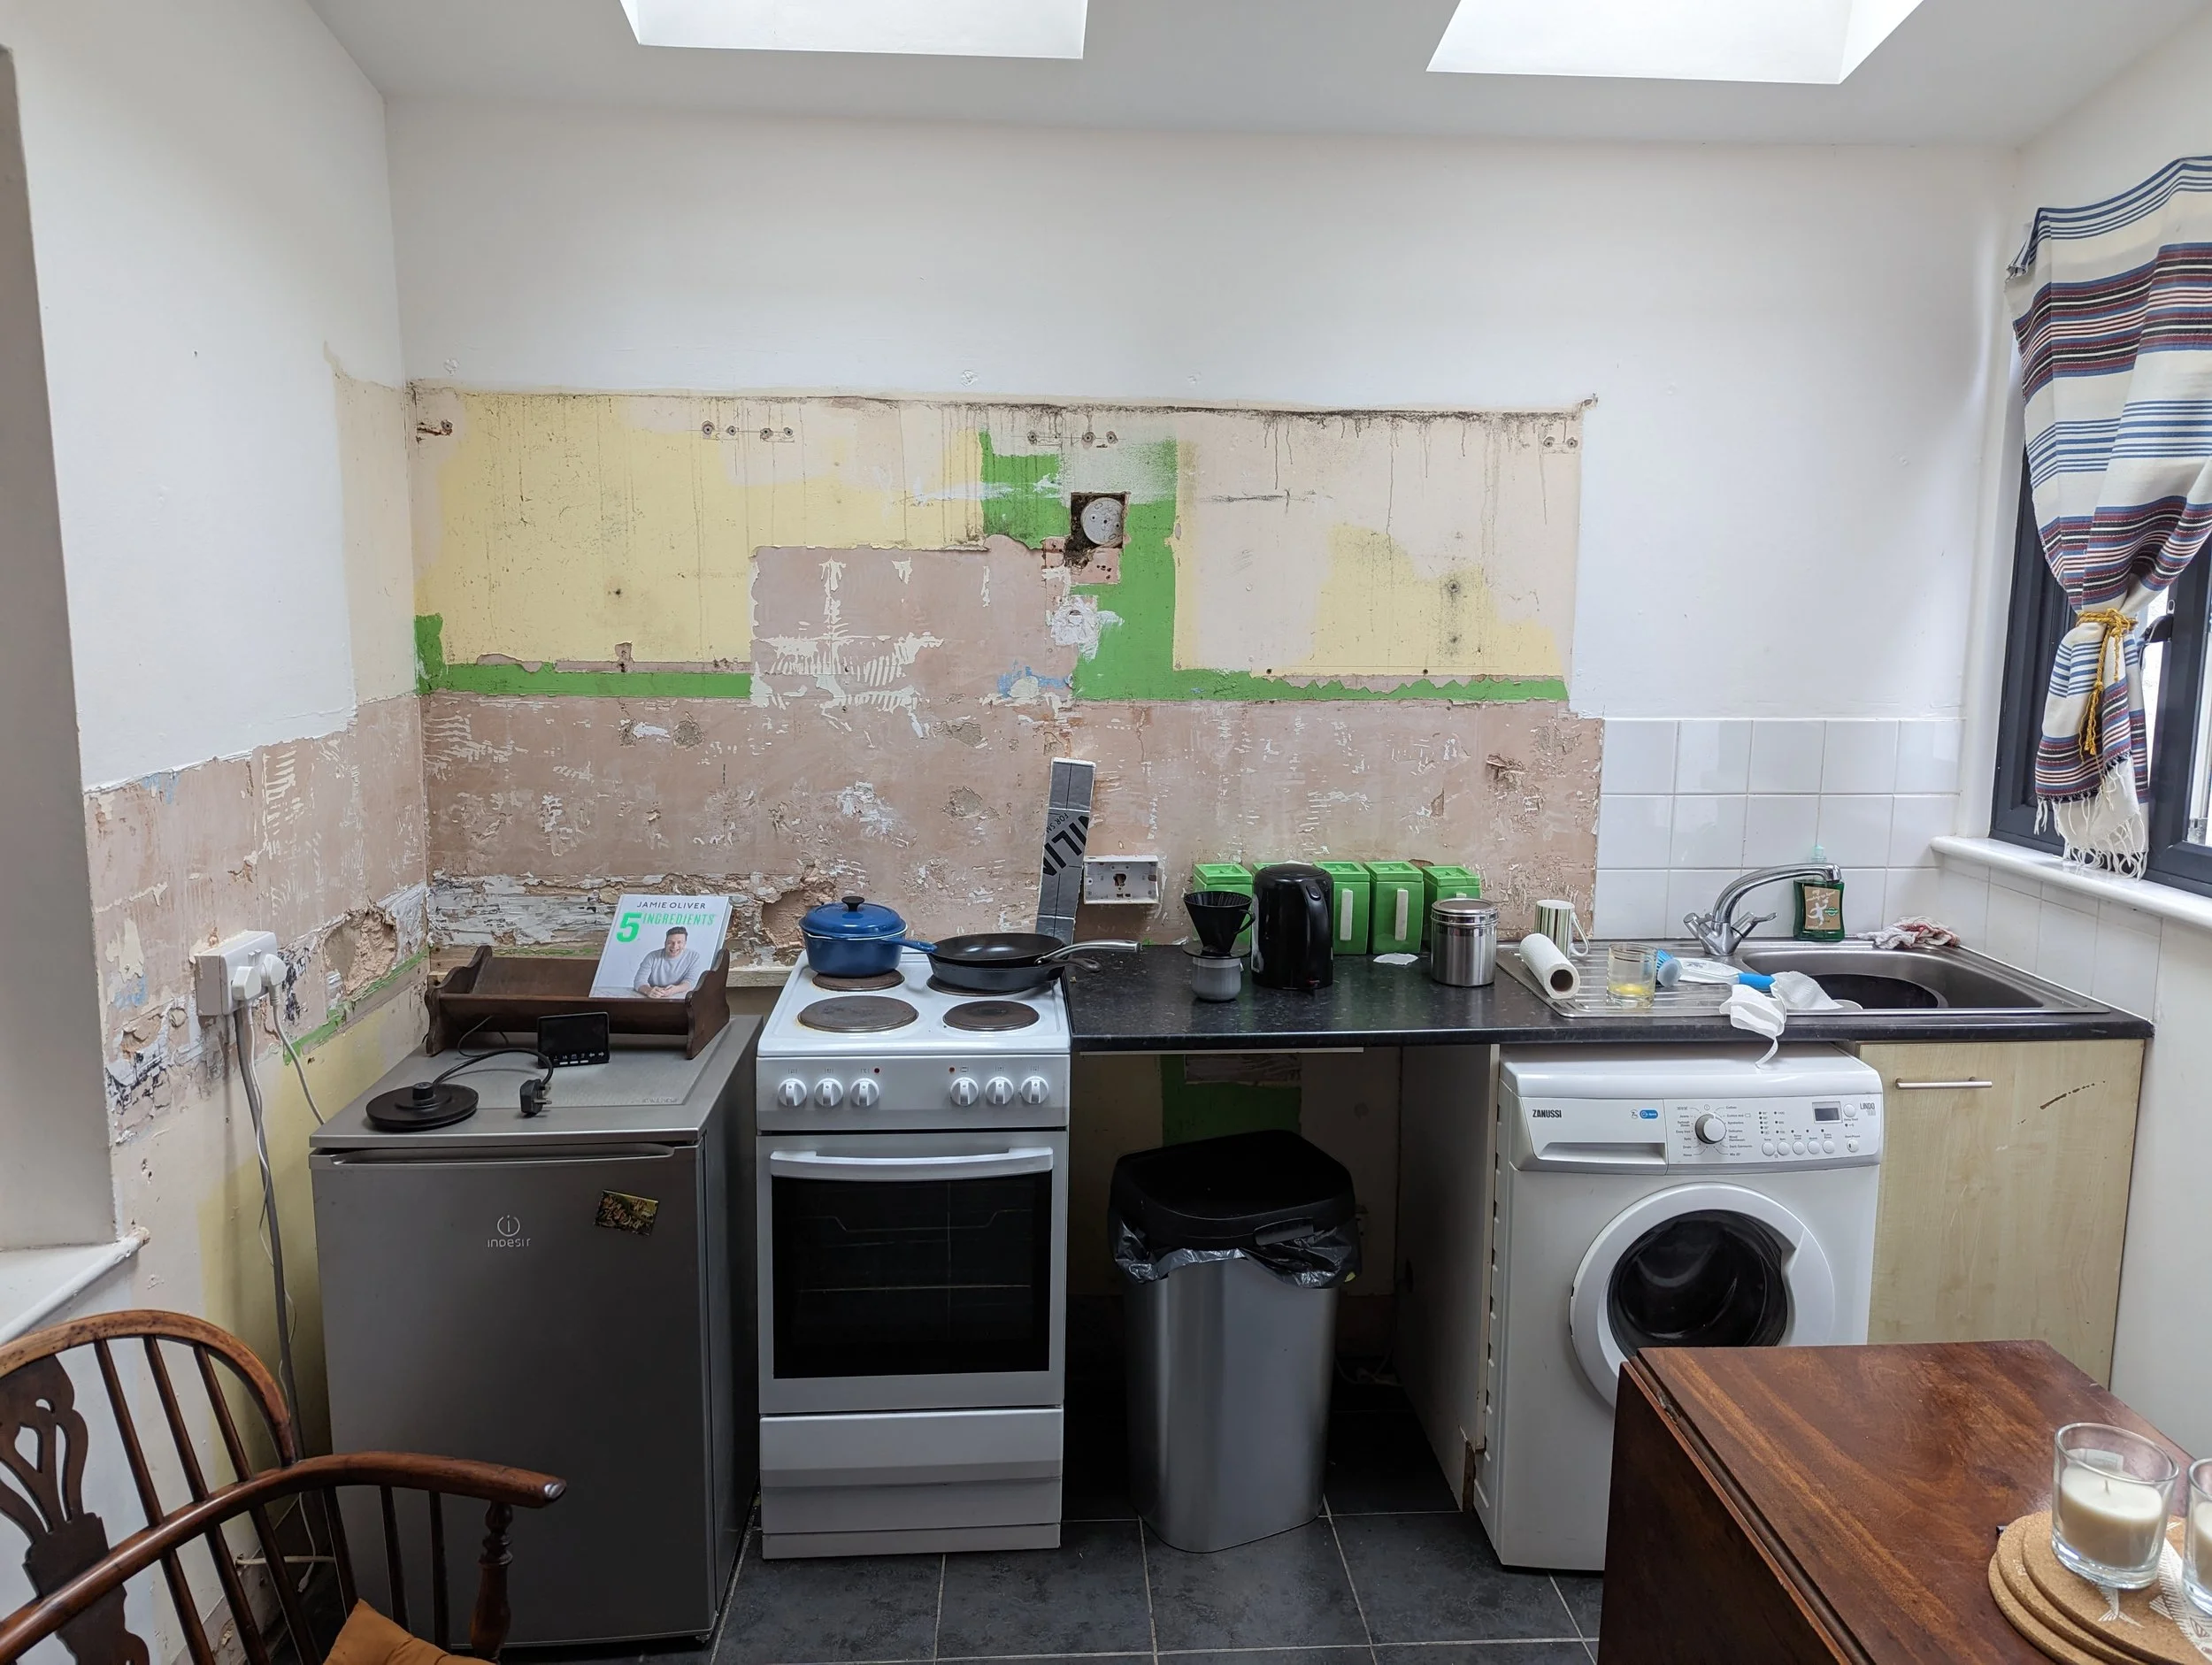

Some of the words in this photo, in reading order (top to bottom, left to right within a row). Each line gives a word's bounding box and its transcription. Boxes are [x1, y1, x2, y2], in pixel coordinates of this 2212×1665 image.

[1055, 813, 1069, 825] FOR
[616, 911, 642, 943] 5
[642, 913, 716, 926] INGREDIENTS
[1532, 1109, 1562, 1118] ZANUSSI
